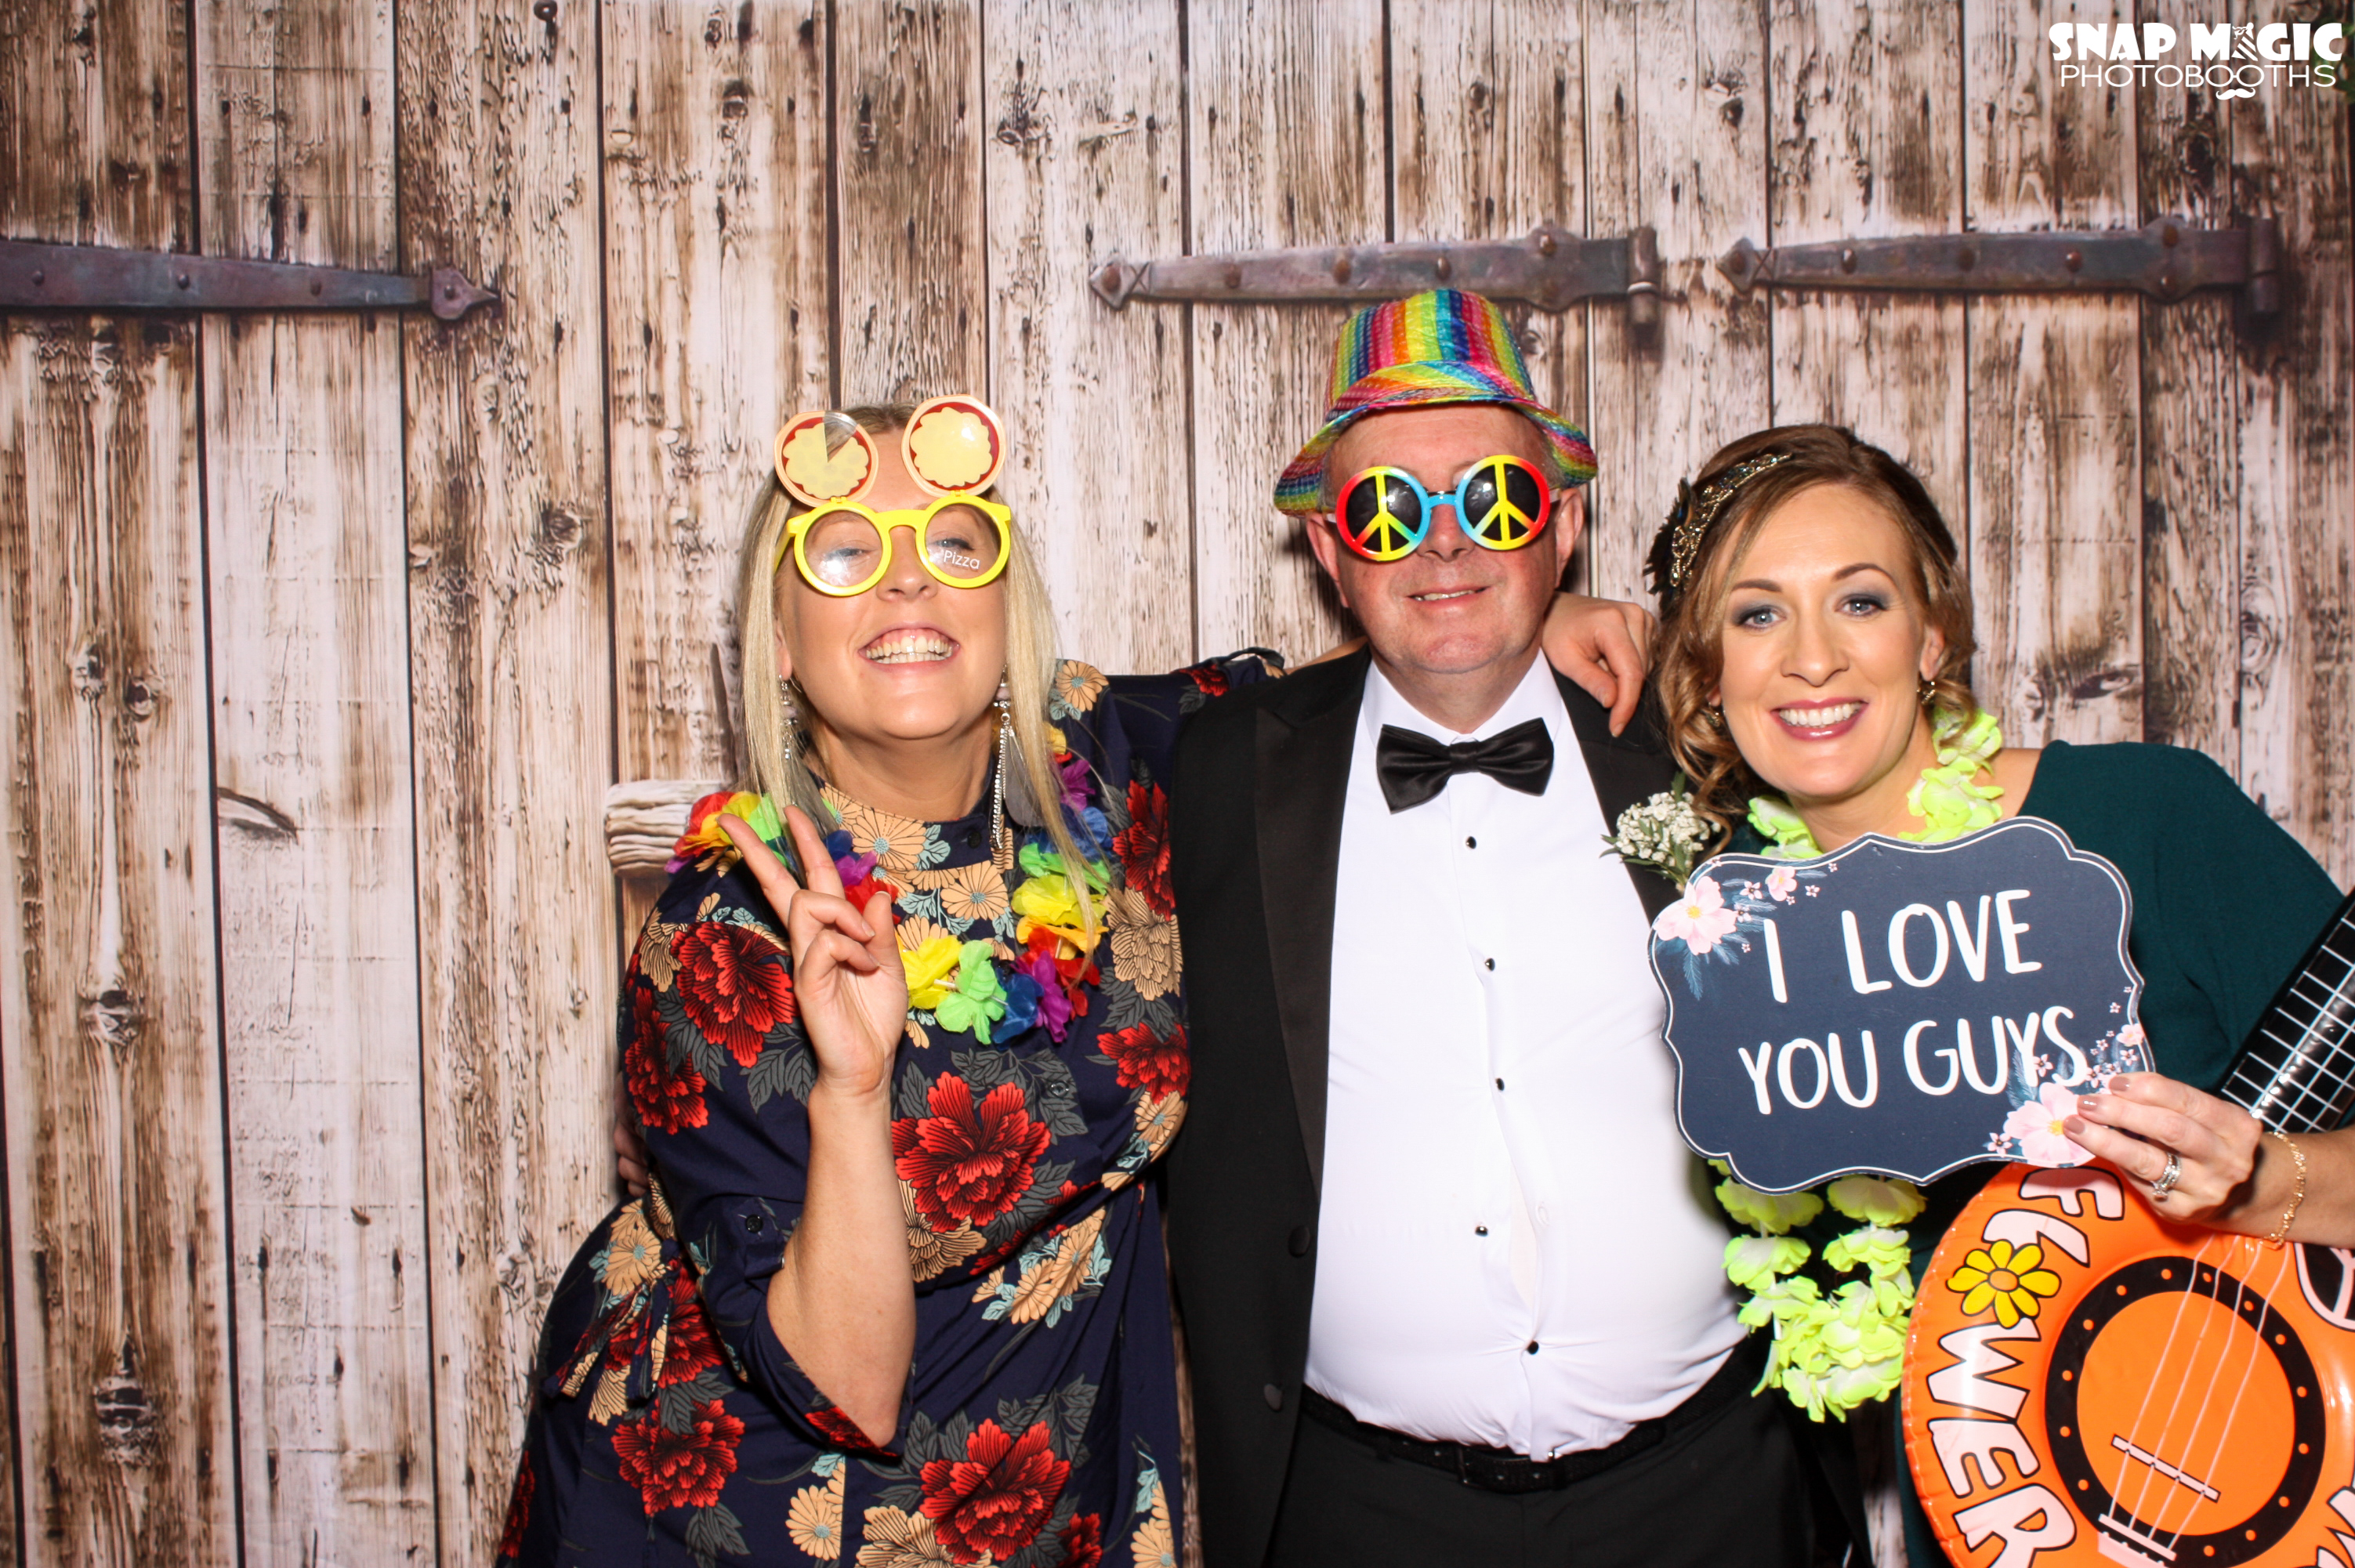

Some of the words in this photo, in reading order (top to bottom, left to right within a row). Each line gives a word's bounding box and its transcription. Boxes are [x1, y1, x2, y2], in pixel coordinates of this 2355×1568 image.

[943, 550, 980, 570] Pizza
[1763, 918, 1788, 1004] I
[1841, 889, 2042, 994] LOVE
[1737, 1029, 1879, 1115] YOU
[1903, 1005, 2089, 1095] GUYS
